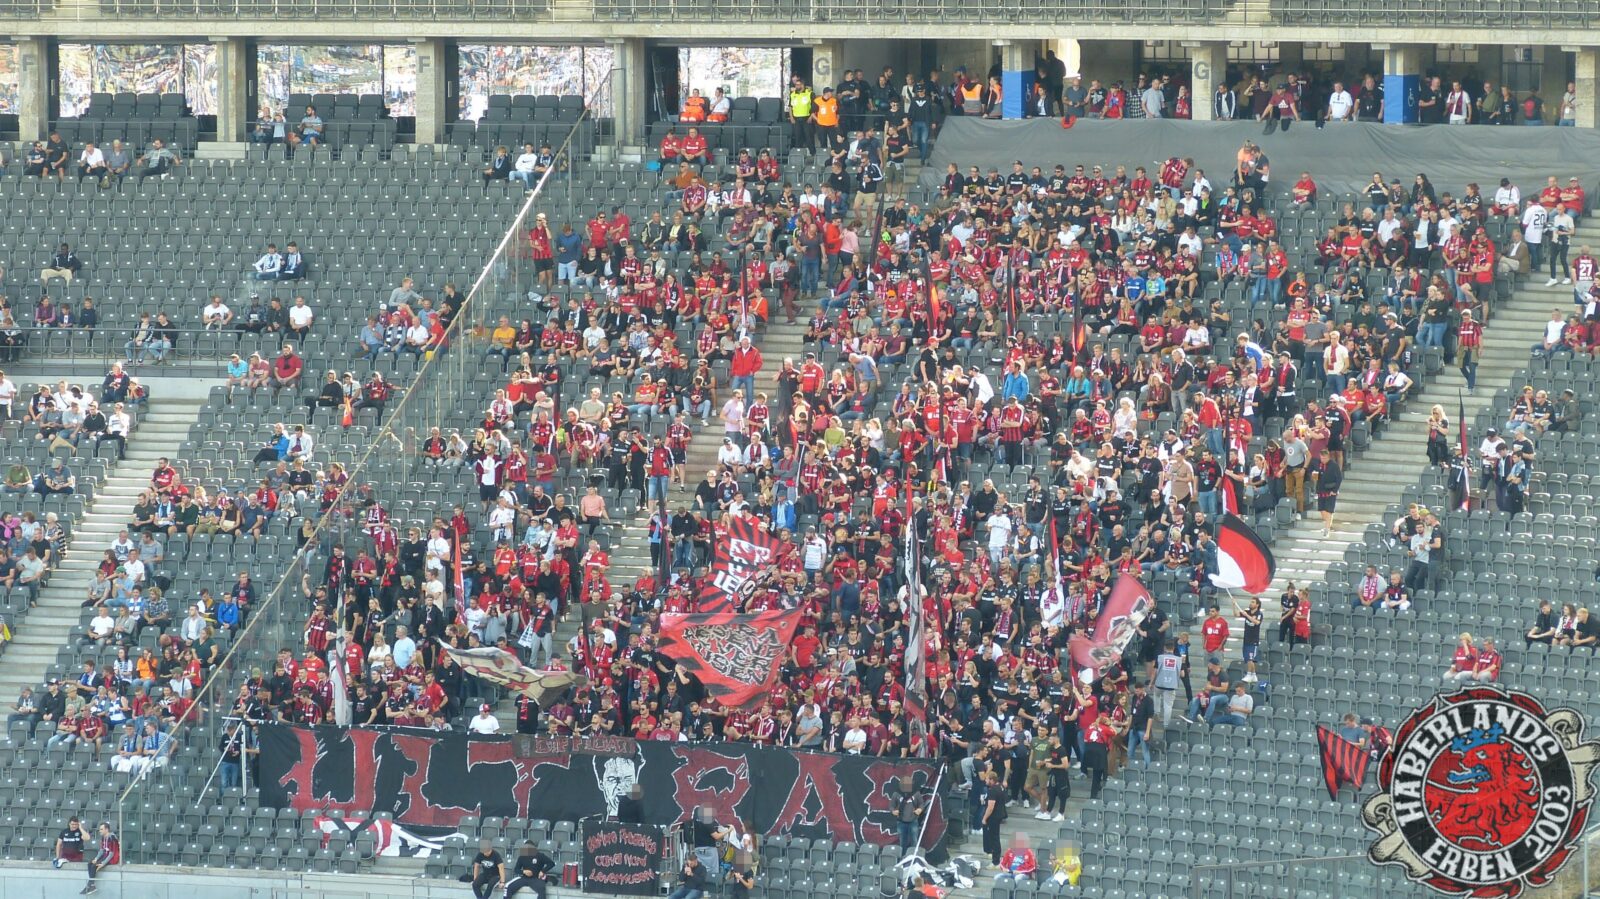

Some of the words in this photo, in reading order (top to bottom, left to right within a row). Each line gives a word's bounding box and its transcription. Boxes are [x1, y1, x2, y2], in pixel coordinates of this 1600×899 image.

[23, 54, 34, 71] F
[419, 56, 431, 73] F
[815, 57, 830, 76] G
[1194, 61, 1210, 80] G
[1533, 213, 1546, 226] 20
[1578, 263, 1593, 277] 27
